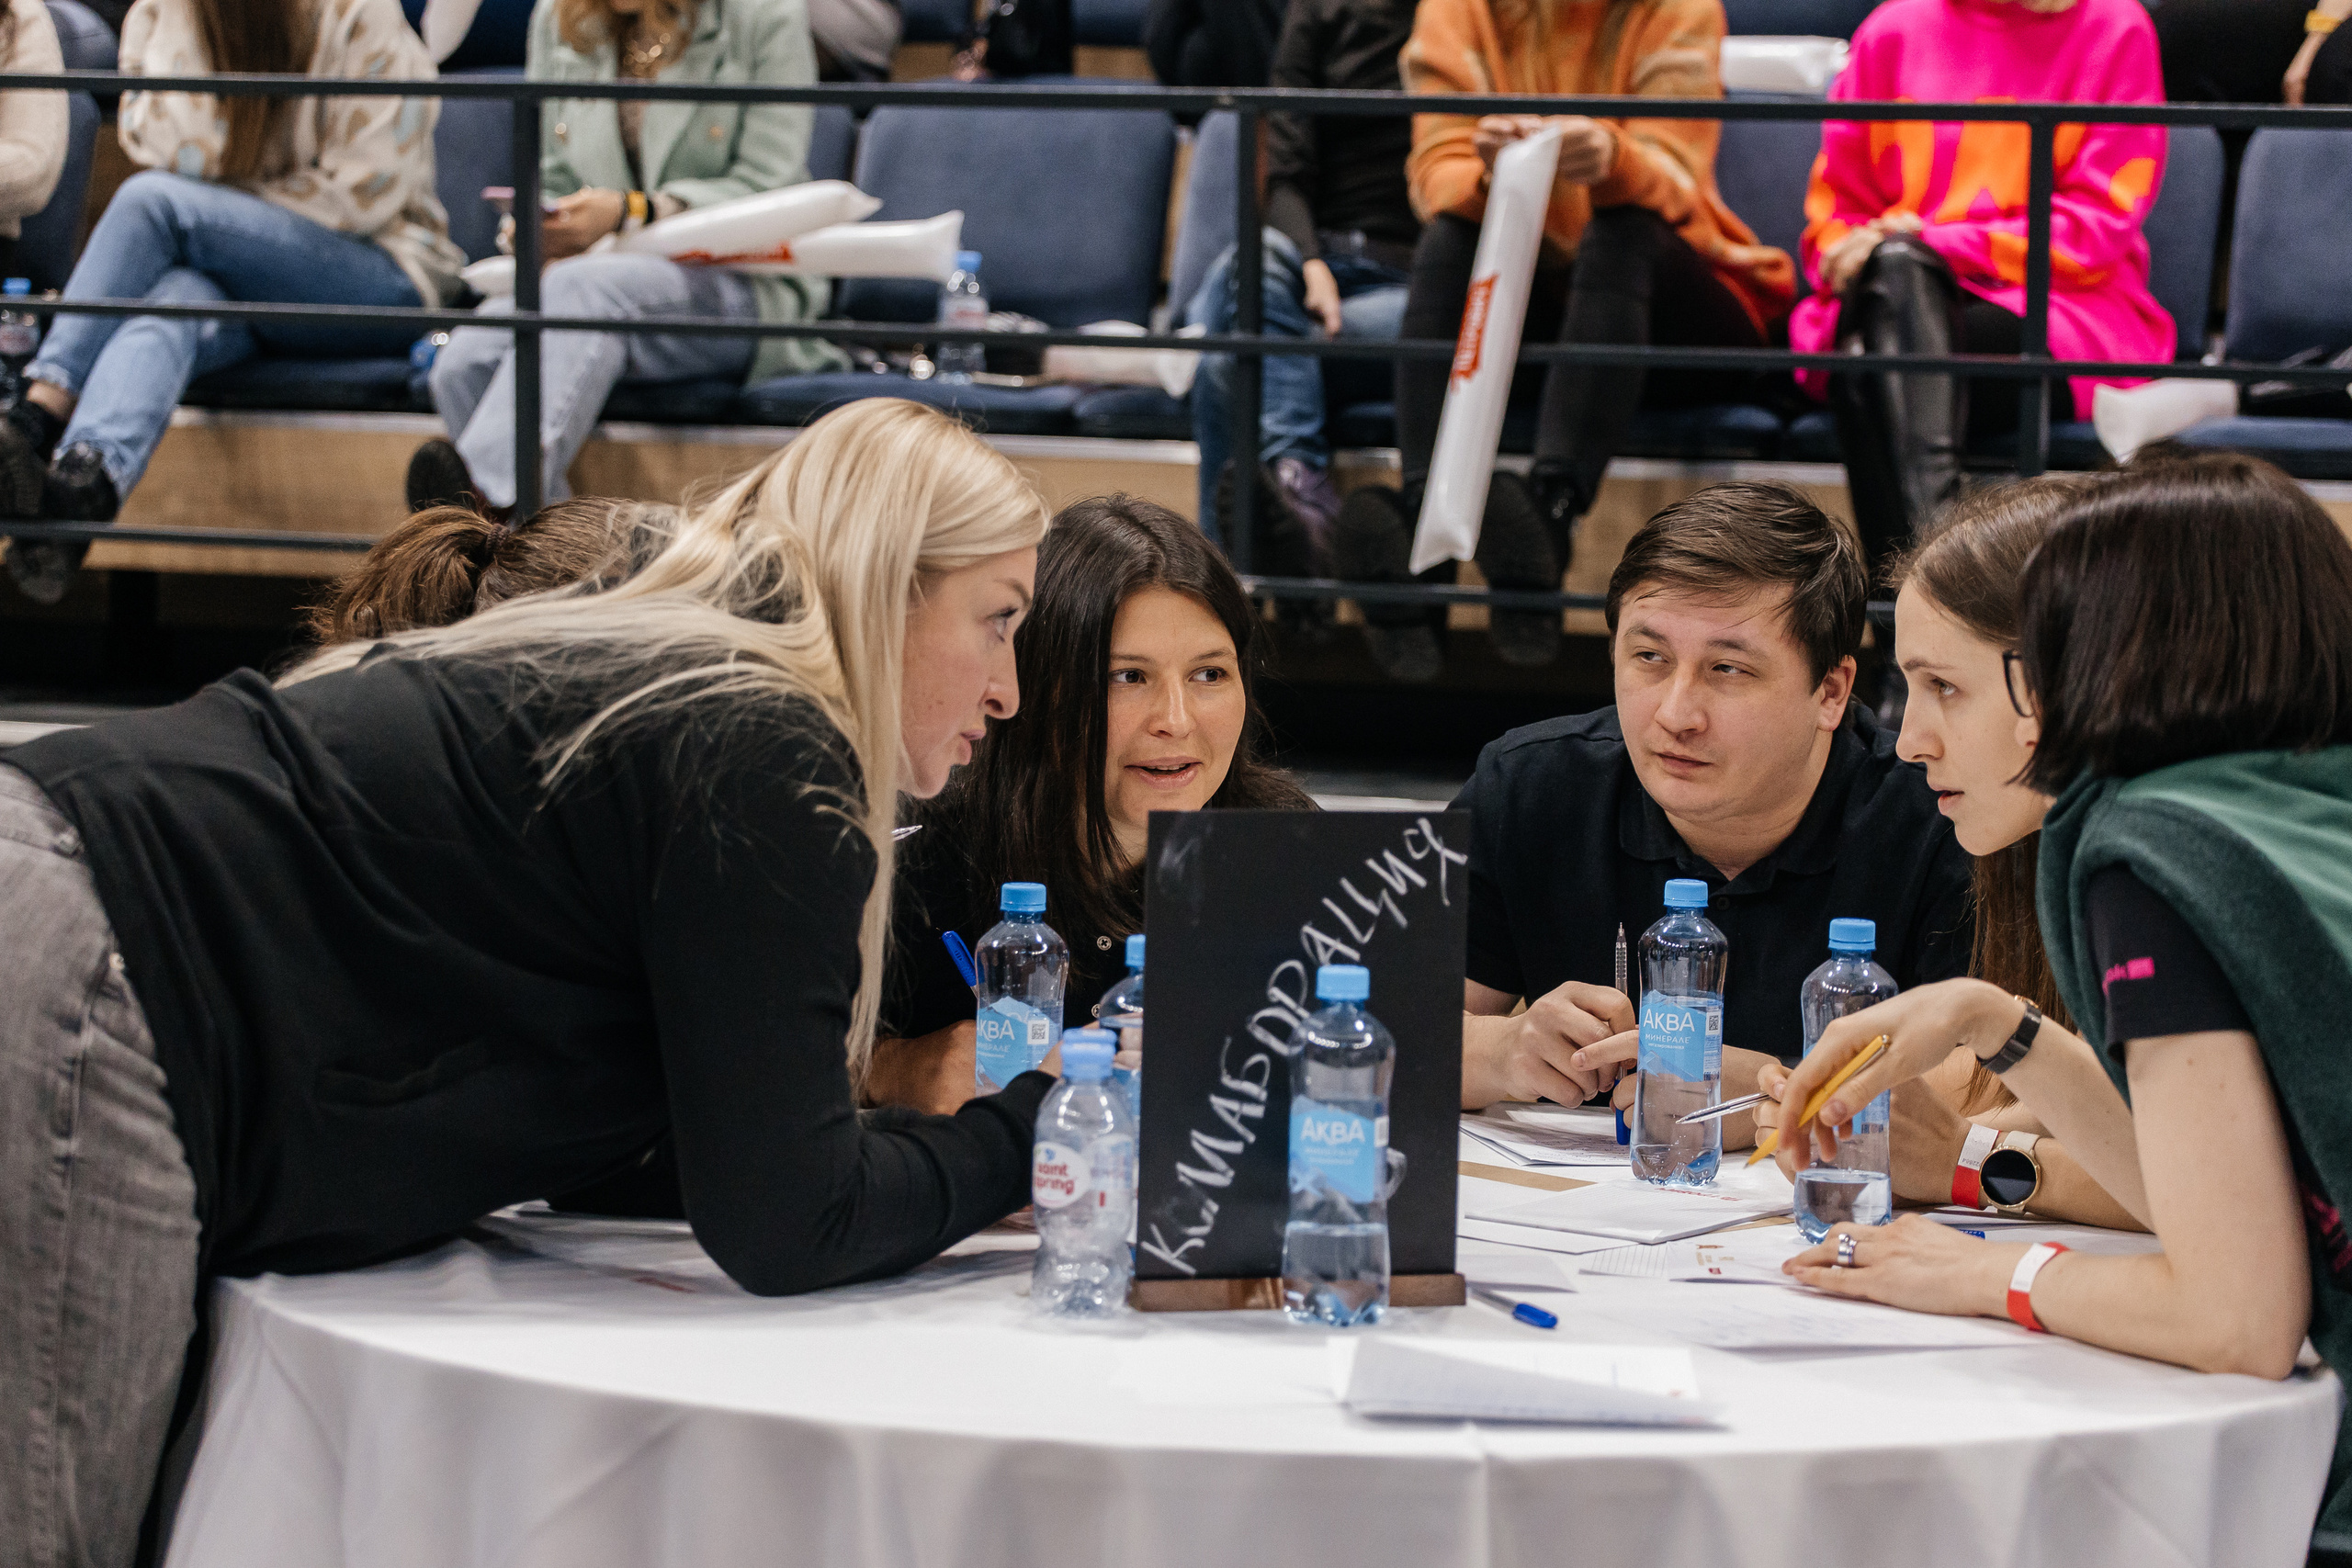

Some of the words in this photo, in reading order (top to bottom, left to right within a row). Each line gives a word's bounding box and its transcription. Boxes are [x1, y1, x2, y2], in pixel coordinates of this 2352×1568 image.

[1643, 1009, 1695, 1034] АКВА
[1645, 1033, 1690, 1044] МИНЕРАЛЕ
[1300, 1116, 1365, 1146] АКВА
[1035, 1178, 1075, 1196] pring
